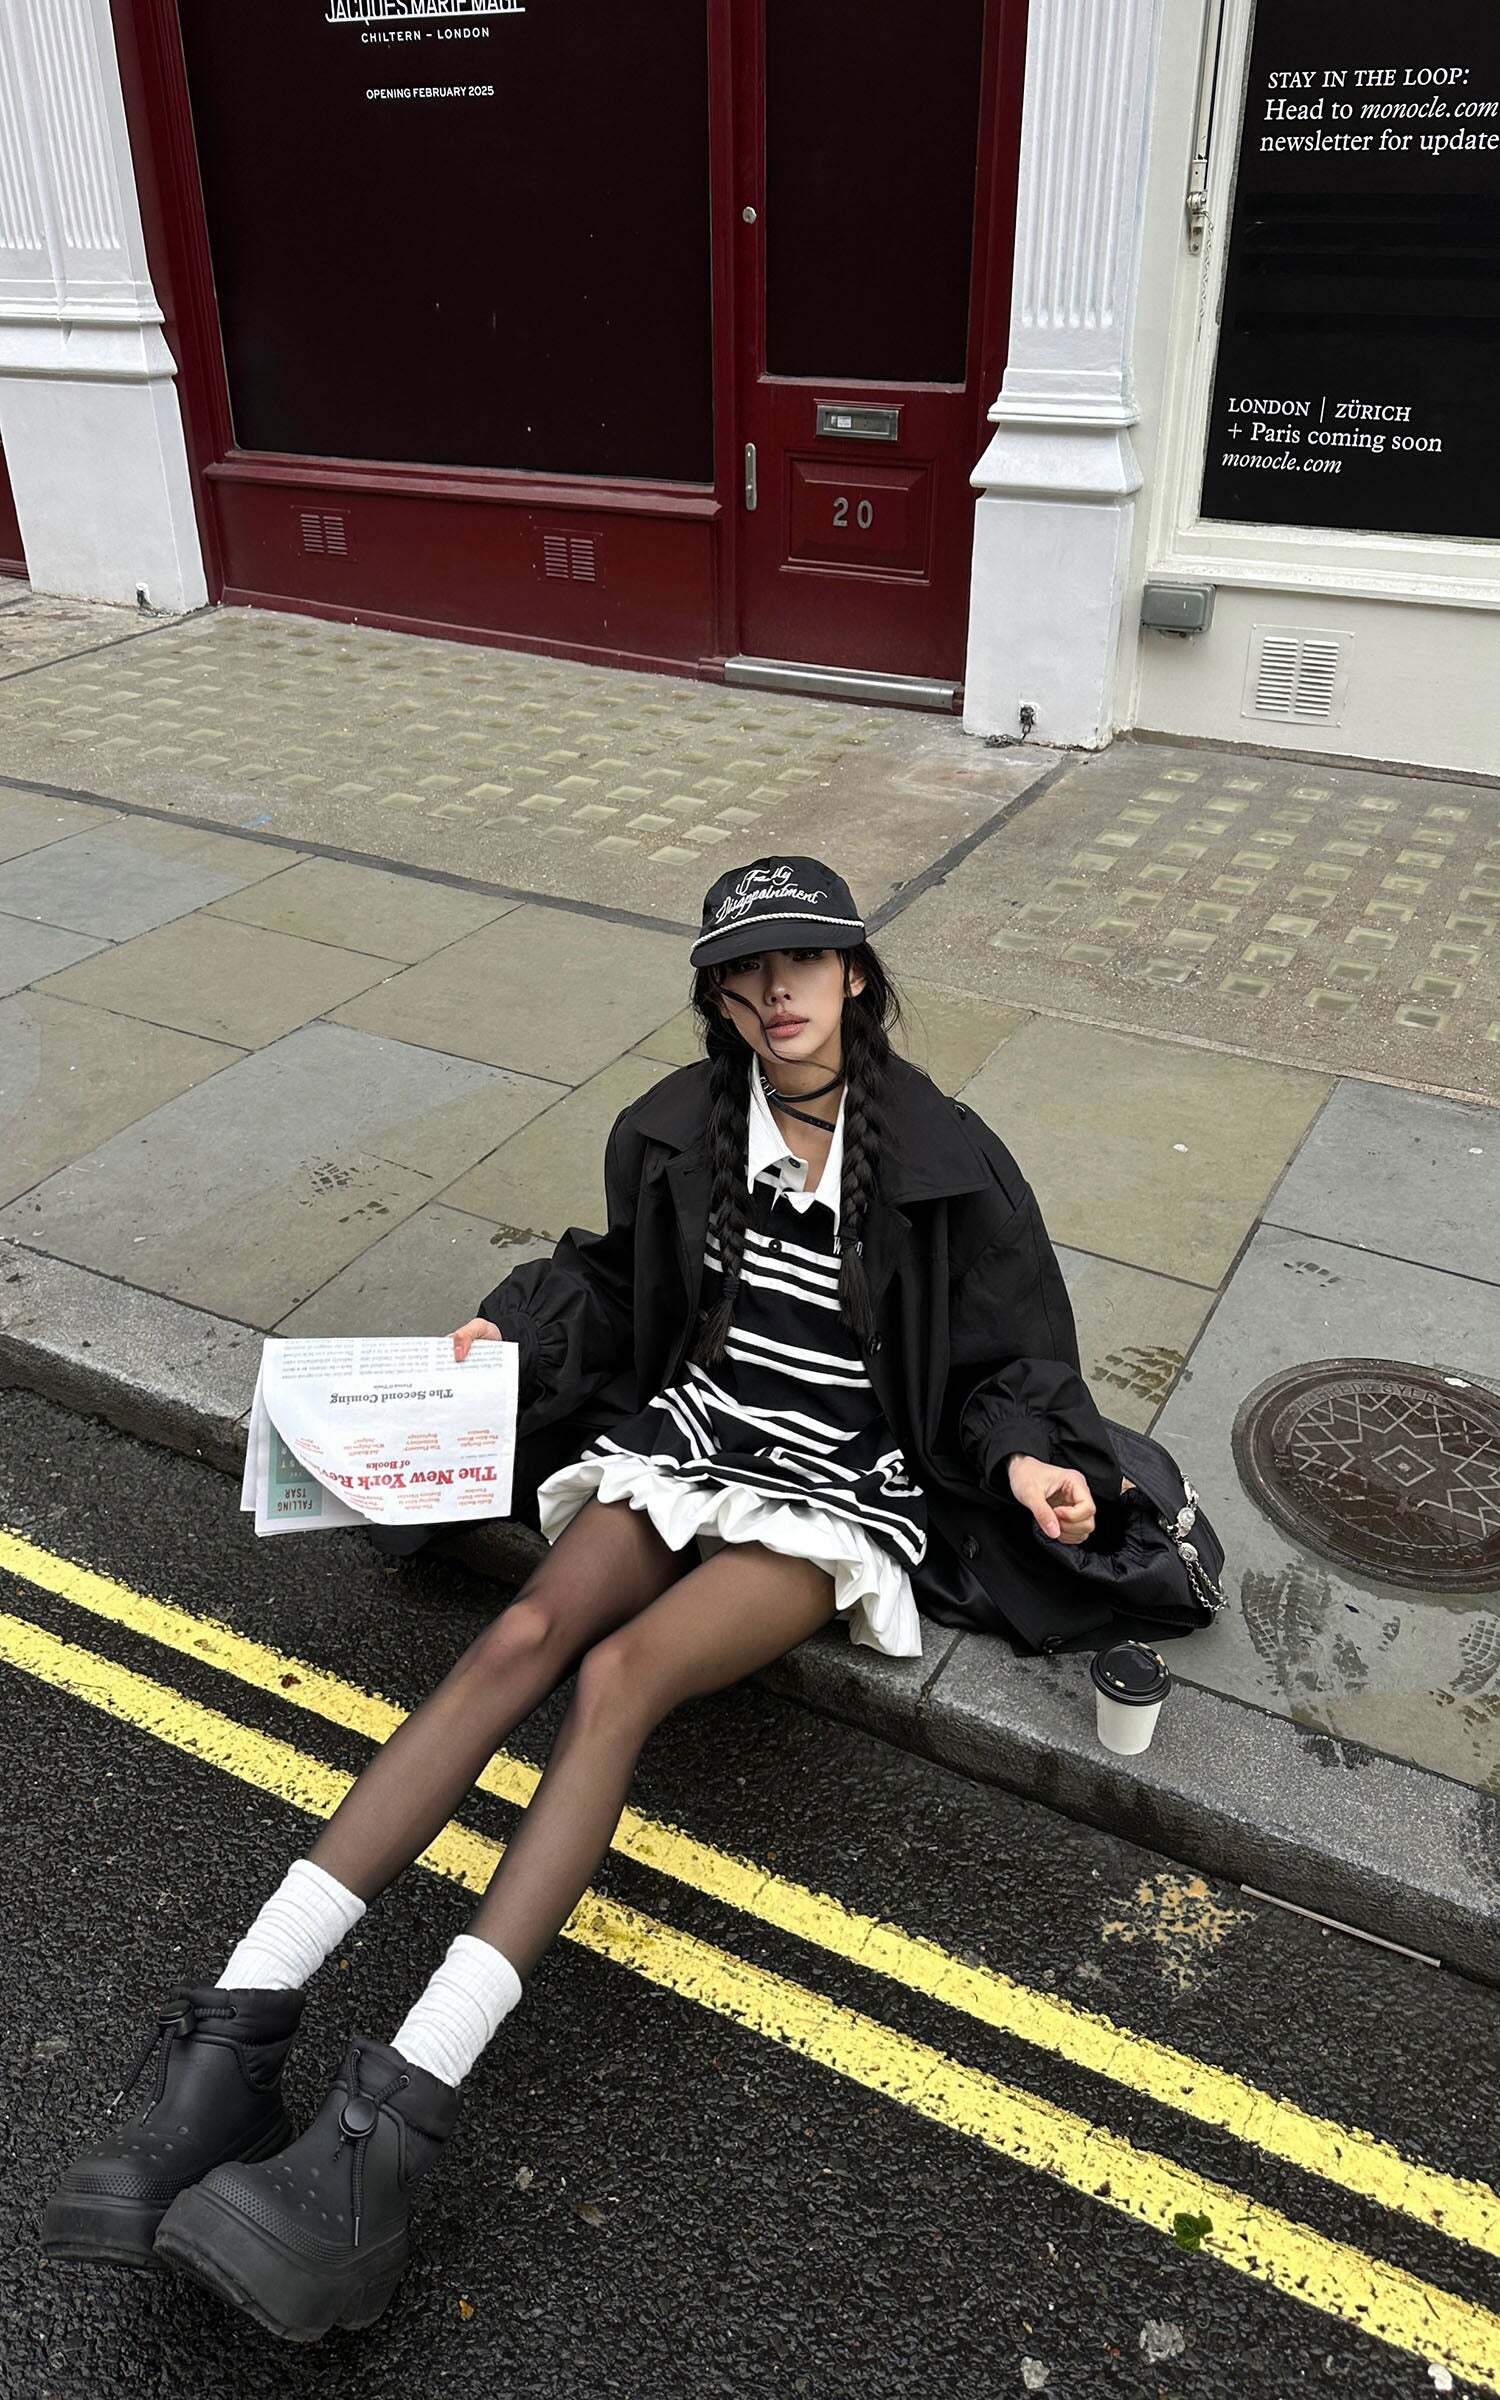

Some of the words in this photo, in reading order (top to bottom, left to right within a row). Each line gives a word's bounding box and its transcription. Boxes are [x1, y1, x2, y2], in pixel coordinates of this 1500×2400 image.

[361, 31, 421, 43] CHILTERN
[437, 28, 490, 40] LONDON
[1268, 71, 1316, 89] STAY
[1322, 70, 1349, 88] IN
[1354, 69, 1396, 87] THE
[1402, 68, 1470, 86] LOOP:
[366, 87, 412, 100] OPENING
[412, 86, 467, 98] FEBRUARY
[468, 85, 495, 97] 2025
[1264, 98, 1324, 121] Head
[1331, 102, 1353, 120] to
[1360, 96, 1499, 119] monocle.com
[1259, 130, 1374, 152] newsletter
[1379, 128, 1413, 151] for
[1228, 398, 1311, 417] LONDON
[1334, 400, 1412, 423] ZÜRICH
[1250, 422, 1301, 444] Paris
[1307, 428, 1387, 453] coming
[1391, 436, 1442, 453] soon
[1222, 450, 1342, 474] monocle.com
[833, 497, 873, 529] 20
[715, 884, 828, 924] Disappointment
[329, 1392, 379, 1406] Coming
[381, 1390, 427, 1404] Second
[428, 1388, 454, 1399] The
[366, 1460, 397, 1471] Books
[399, 1459, 410, 1469] of
[357, 1472, 407, 1490] York
[409, 1469, 455, 1486] New
[459, 1466, 497, 1482] The
[285, 1488, 307, 1499] TSAR
[277, 1499, 313, 1512] FALLING
